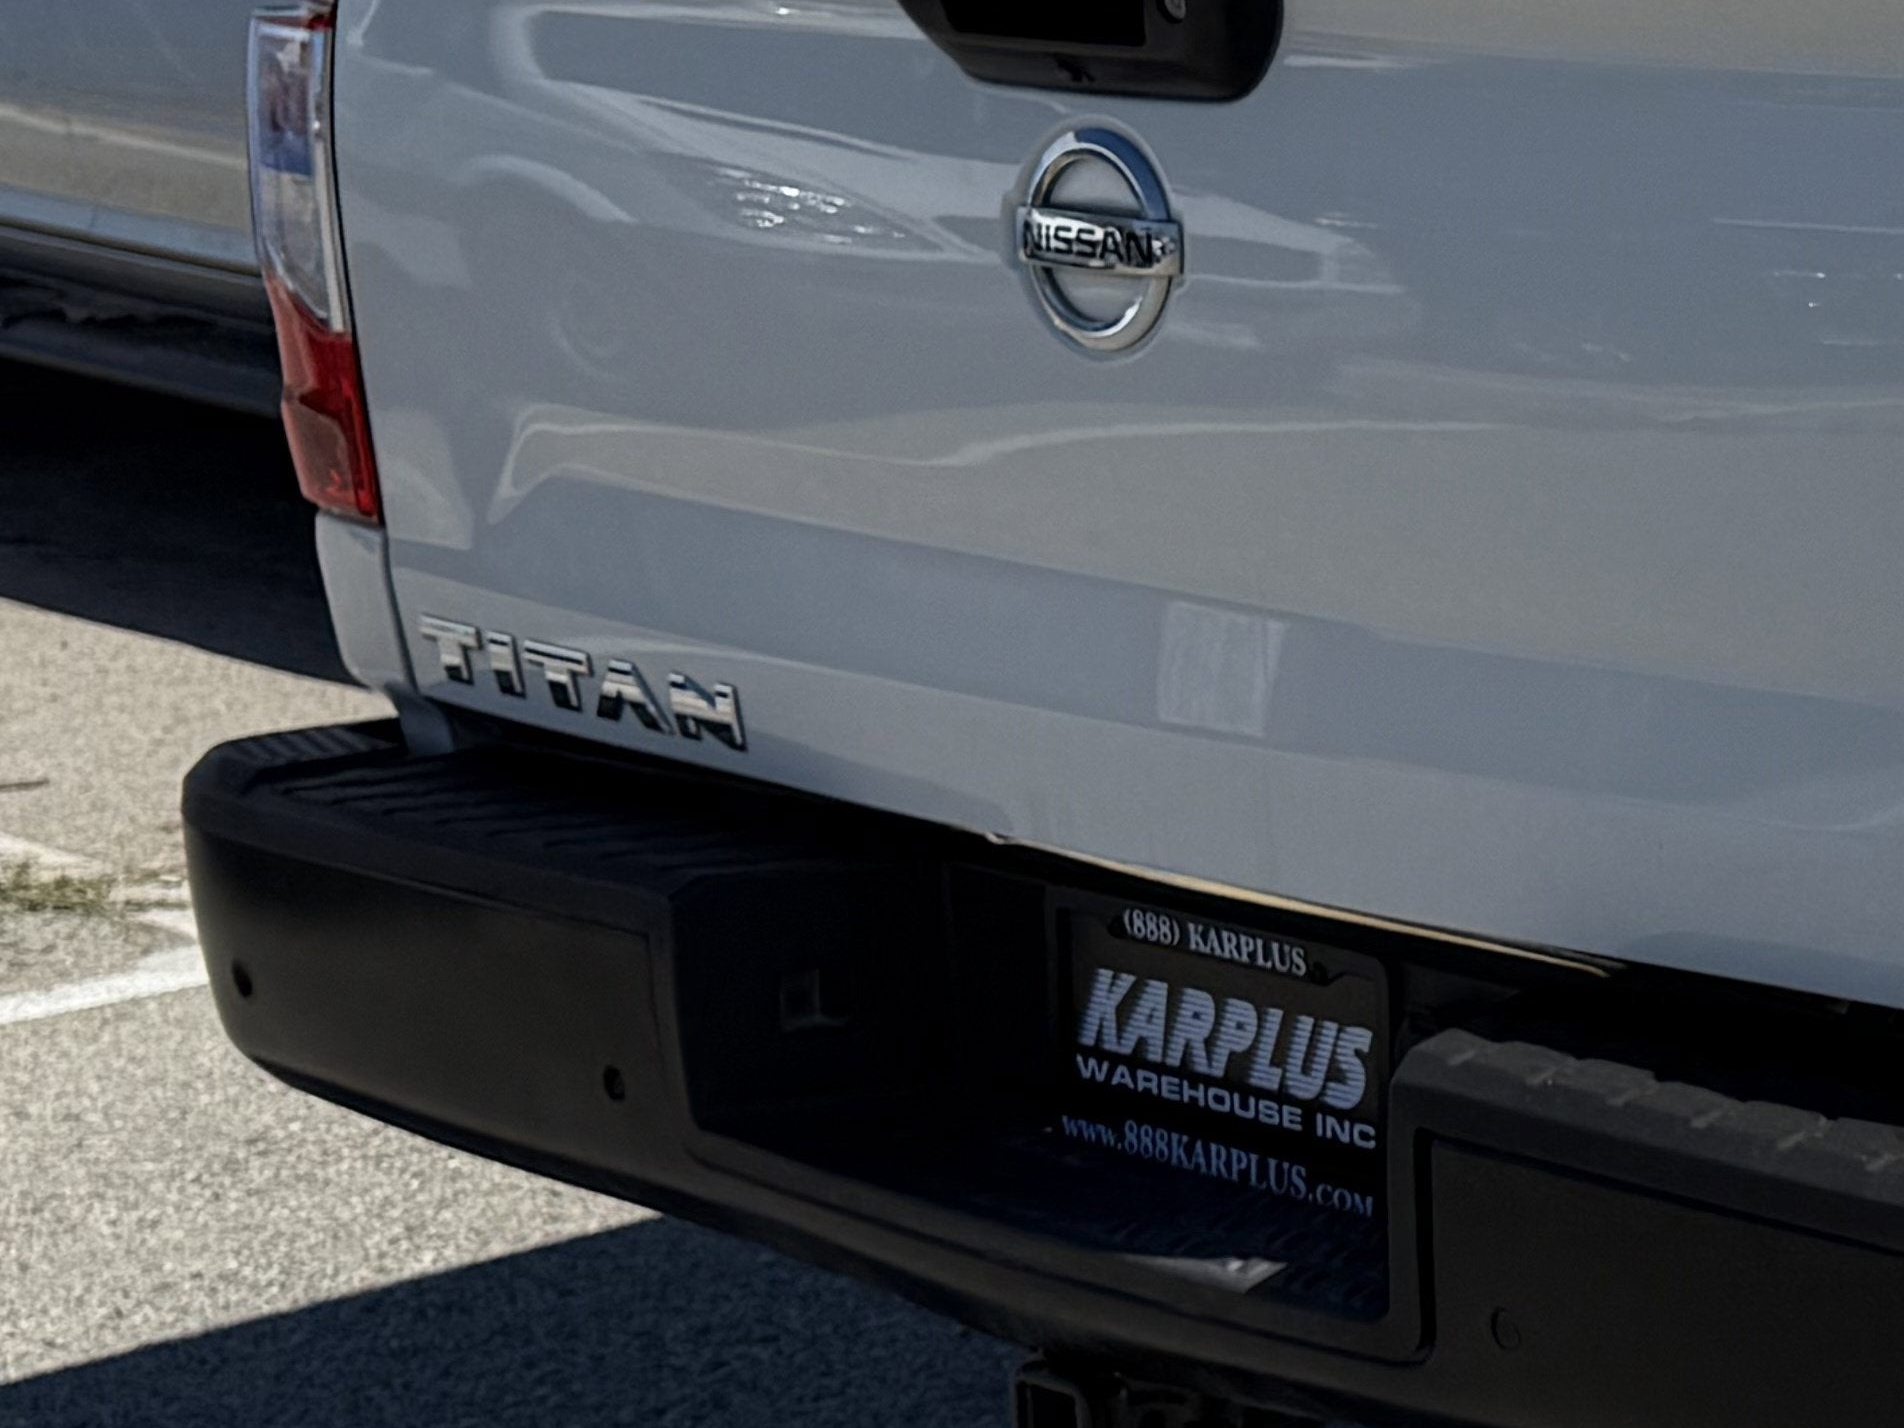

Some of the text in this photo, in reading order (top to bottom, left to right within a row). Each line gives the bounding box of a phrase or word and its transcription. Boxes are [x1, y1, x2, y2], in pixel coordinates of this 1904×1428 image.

[1023, 220, 1153, 268] NISSAN
[418, 612, 749, 753] TITAN
[1123, 906, 1308, 978] (888) KARPLUS
[1078, 967, 1374, 1112] KARPLUS
[1075, 1053, 1378, 1150] WAREHOUSE INC
